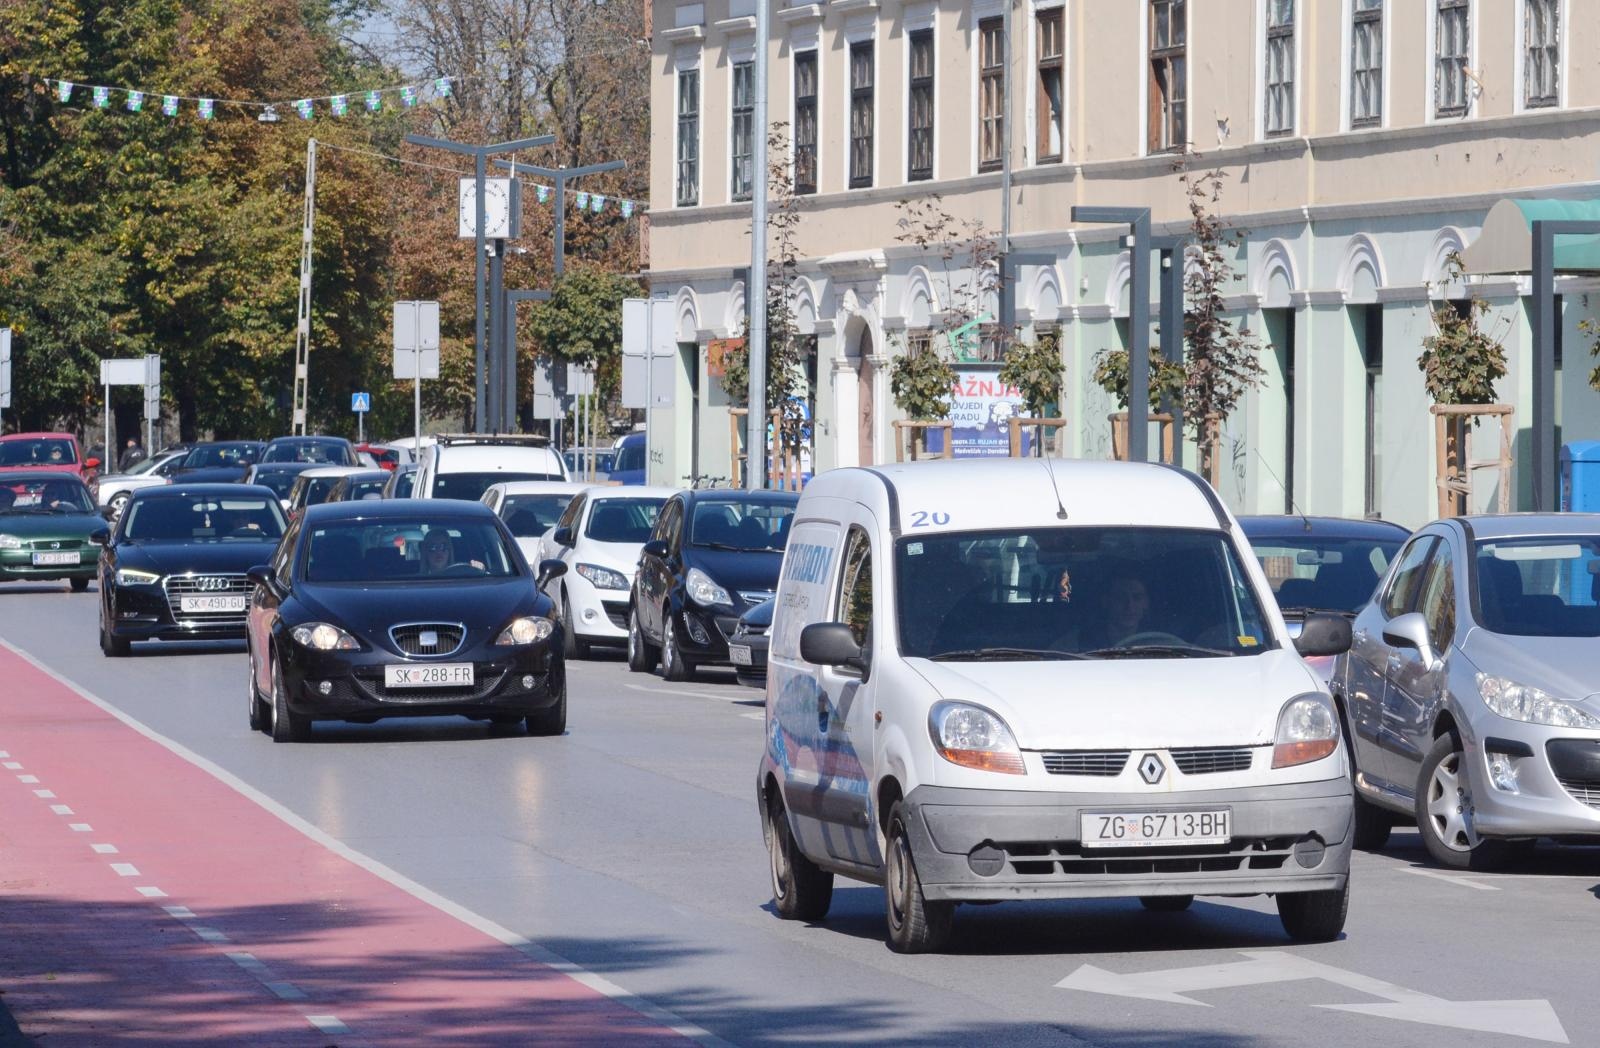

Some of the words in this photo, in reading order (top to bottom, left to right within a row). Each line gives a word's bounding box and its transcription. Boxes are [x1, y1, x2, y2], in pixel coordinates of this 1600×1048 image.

[952, 375, 1024, 397] AŽNJA
[189, 598, 200, 608] SK
[208, 597, 243, 608] 490-GU
[396, 669, 411, 683] SK
[422, 667, 471, 682] 288-FR
[1099, 816, 1125, 839] ZG
[1142, 813, 1227, 838] 6713-BH
